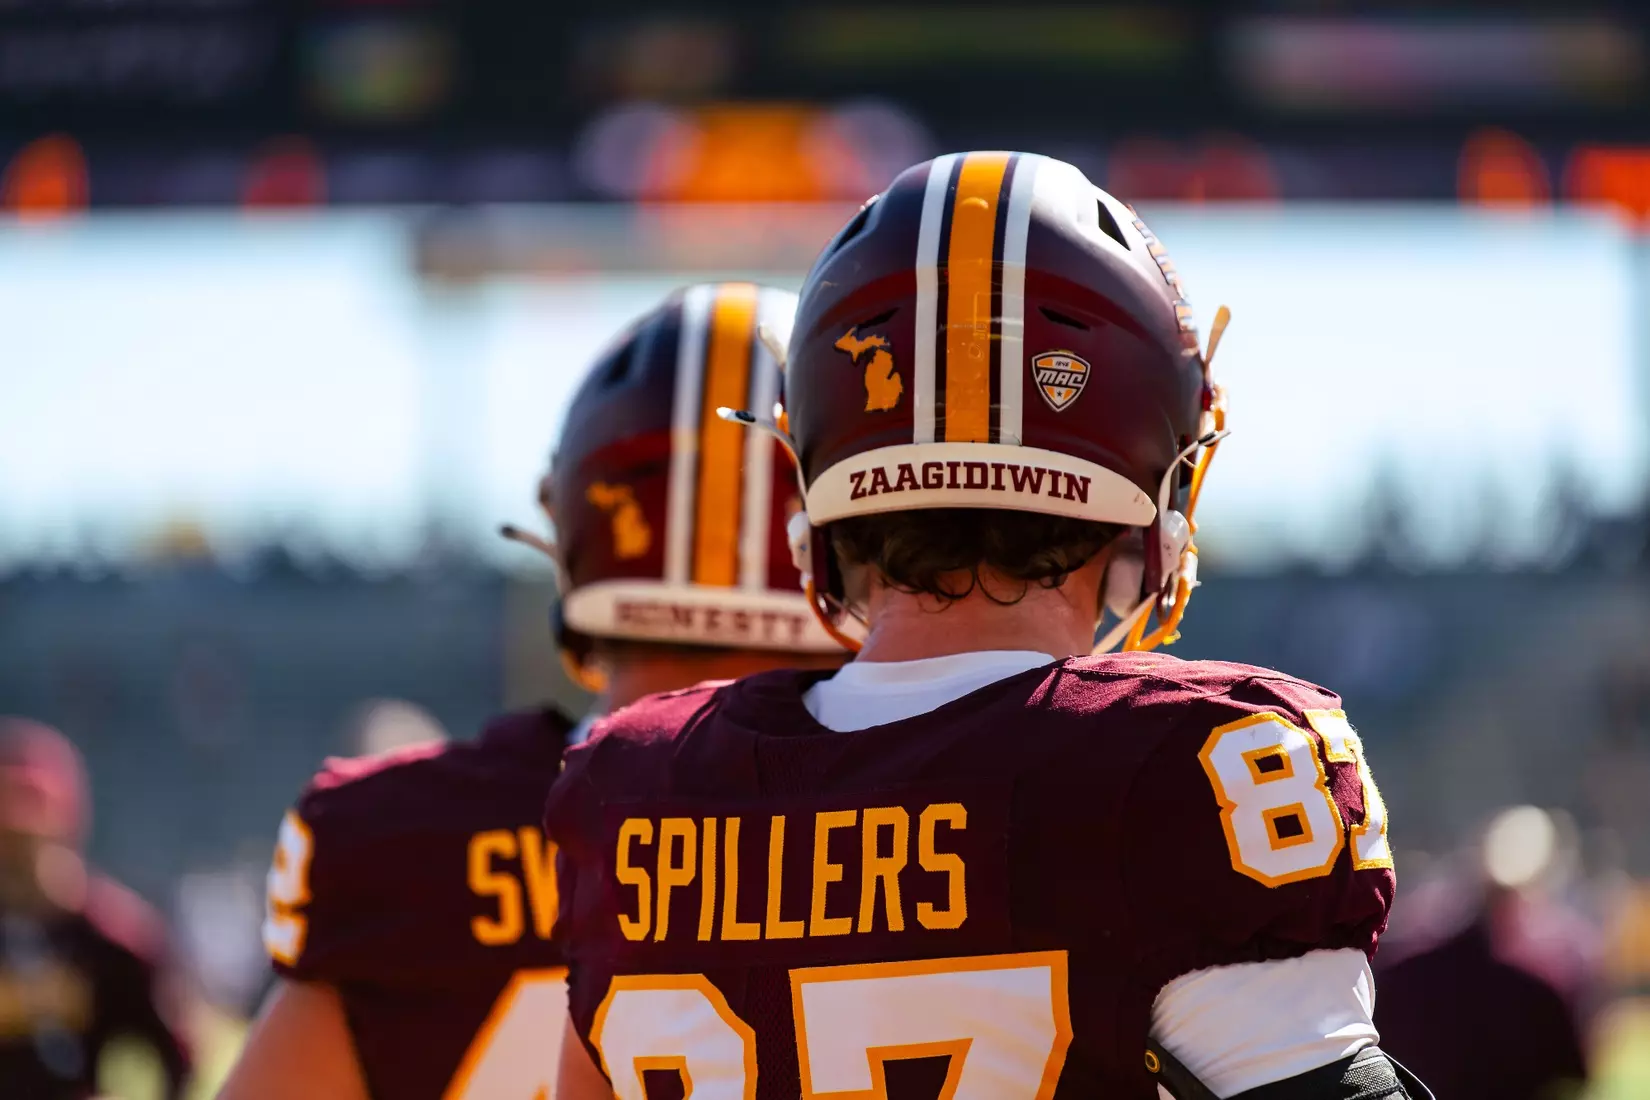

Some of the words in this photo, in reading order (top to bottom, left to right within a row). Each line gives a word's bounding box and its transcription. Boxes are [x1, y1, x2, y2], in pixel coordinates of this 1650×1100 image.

[1037, 369, 1084, 388] MAC
[850, 461, 1091, 504] ZAAGIDIWIN
[616, 803, 968, 942] SPILLERS
